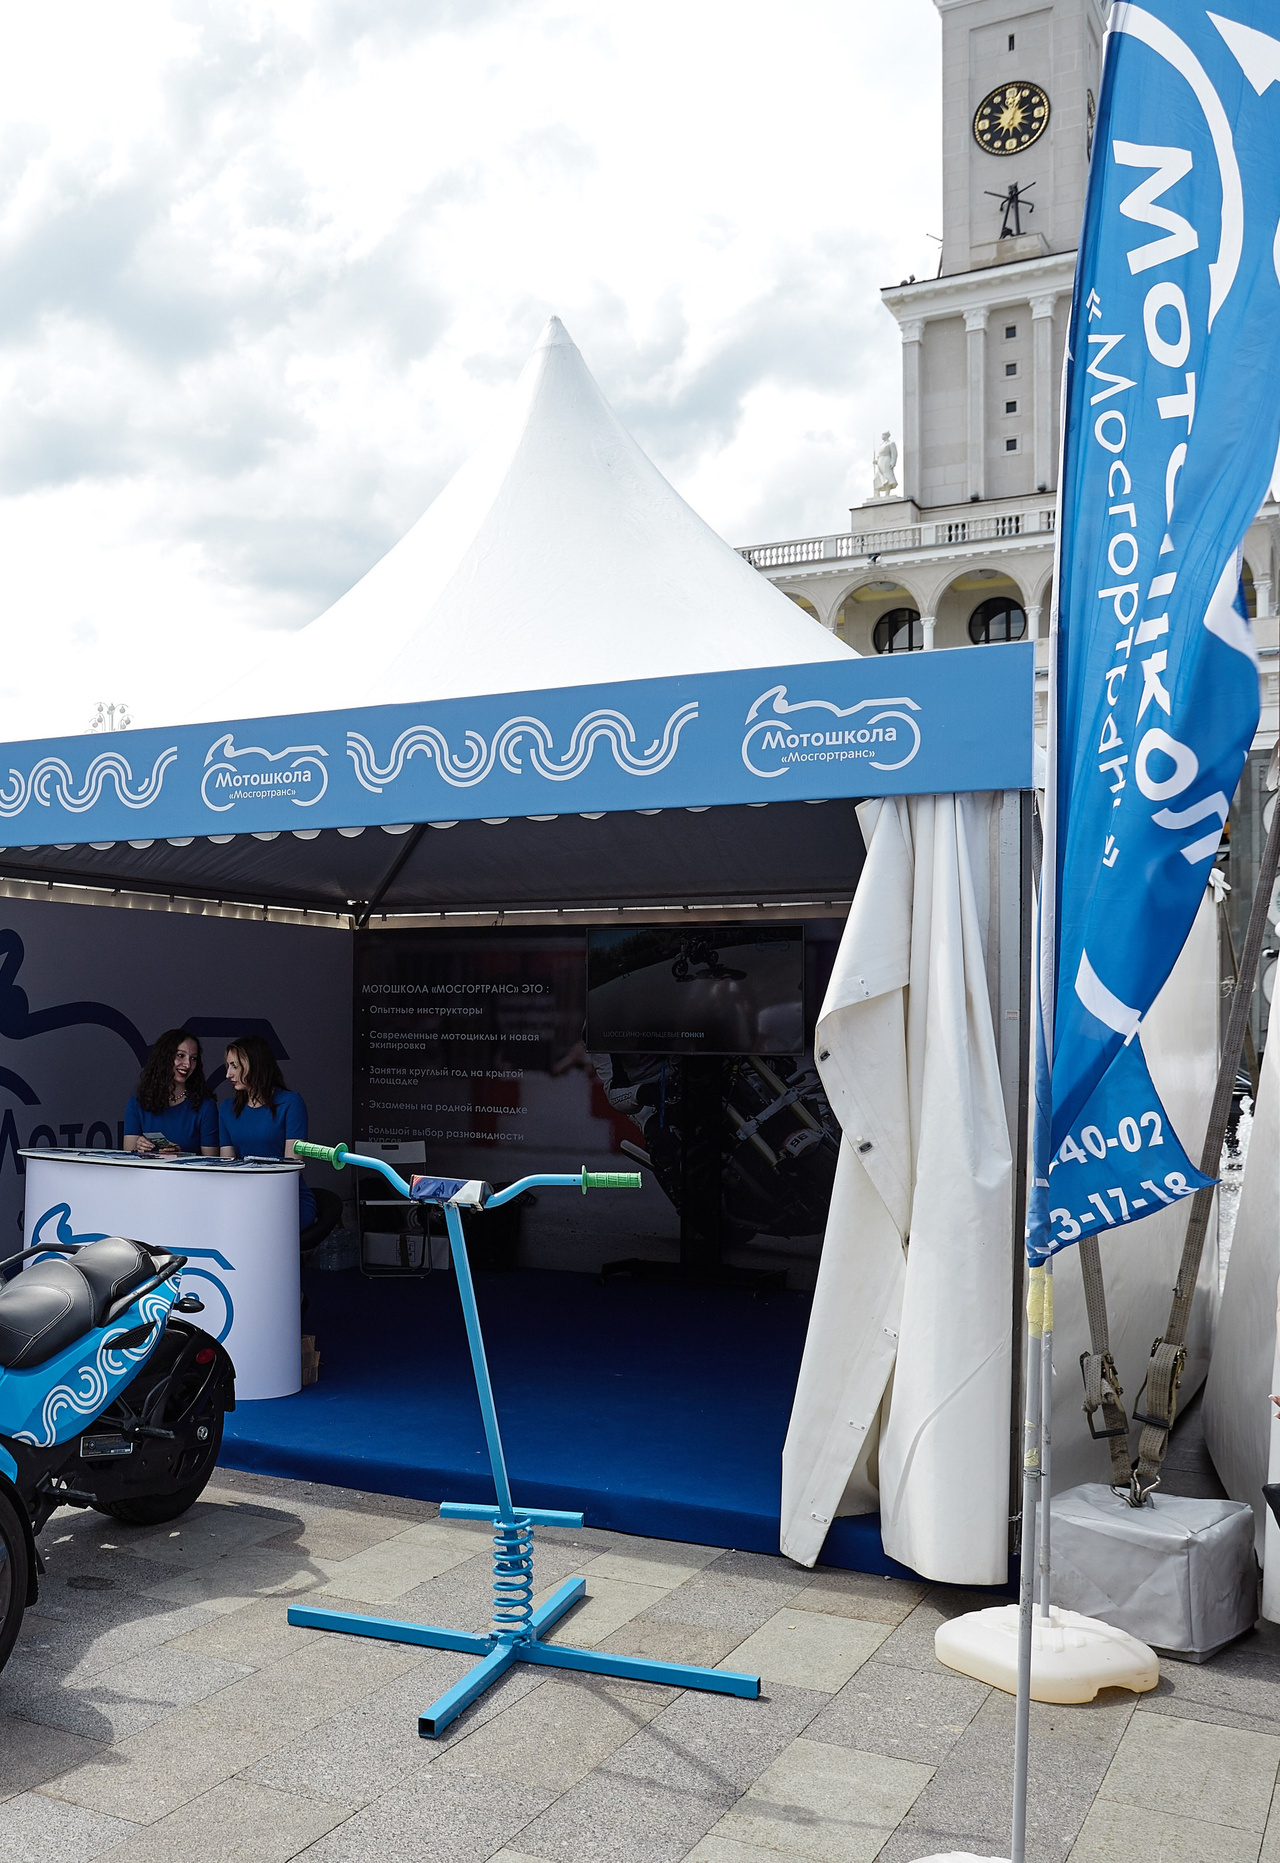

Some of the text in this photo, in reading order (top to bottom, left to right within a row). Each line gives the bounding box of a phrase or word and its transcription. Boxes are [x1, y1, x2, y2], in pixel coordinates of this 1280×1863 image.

[761, 726, 897, 750] Мотошкола
[780, 749, 876, 763] «Мосгортранс»
[214, 769, 312, 788] Мотошкола
[228, 788, 297, 800] «Мосгортранс»
[361, 984, 429, 994] МОТОШКОЛА
[431, 984, 519, 994] «МОСГОРТРАНС»
[369, 1005, 483, 1017] Опытные инструкторы
[369, 1030, 439, 1042] Современные
[441, 1032, 498, 1043] мотоциклы
[509, 1033, 540, 1042] новая
[369, 1042, 426, 1051] экипировка
[369, 1066, 407, 1075] Занятия
[409, 1066, 449, 1078] круглый
[485, 1068, 524, 1080] крытой
[369, 1077, 419, 1086] площадке
[368, 1100, 418, 1111] Экзамены
[435, 1103, 473, 1114] родной
[475, 1106, 528, 1116] площадке
[368, 1125, 524, 1142] Большой выбор разновидности
